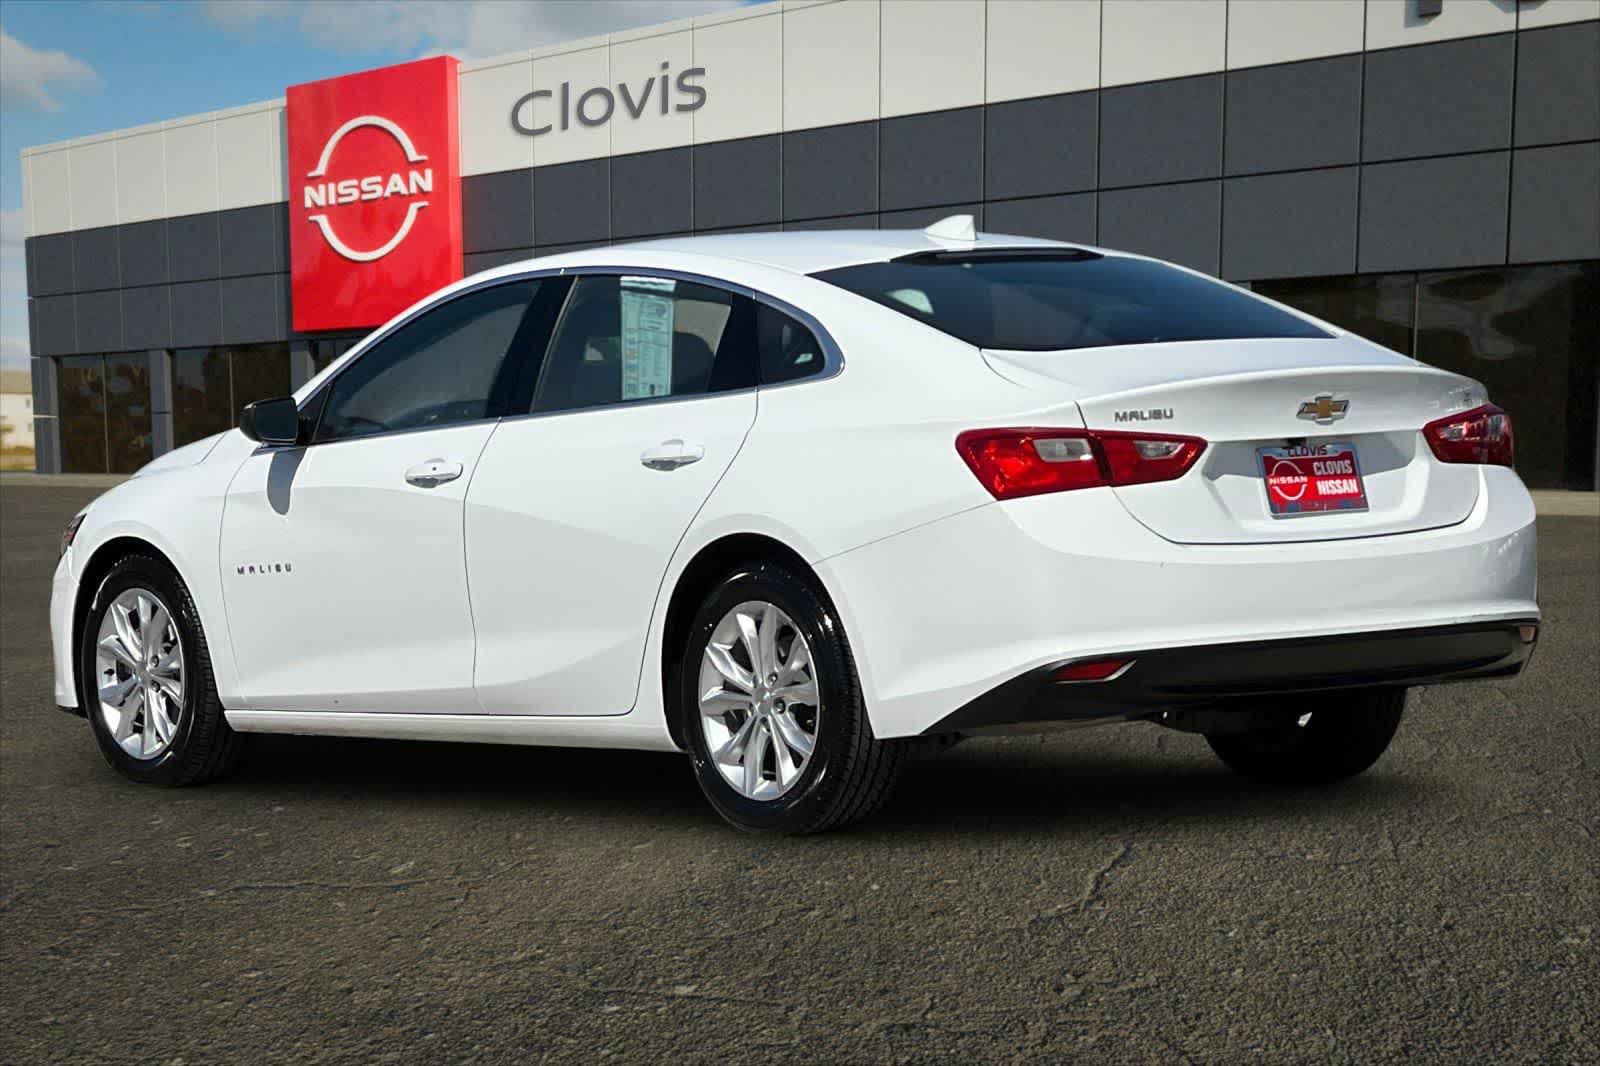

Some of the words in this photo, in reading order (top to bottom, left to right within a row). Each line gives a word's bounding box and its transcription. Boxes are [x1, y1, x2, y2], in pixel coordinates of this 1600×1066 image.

[511, 62, 707, 136] Clovis
[304, 169, 433, 209] NISSAN
[1114, 408, 1174, 422] MALIBU
[1287, 447, 1327, 456] CLOVIS
[1312, 460, 1353, 475] CLOVIS
[1269, 476, 1308, 485] NISSAN
[1316, 479, 1360, 495] NISSAN
[237, 563, 292, 575] MALIBU
